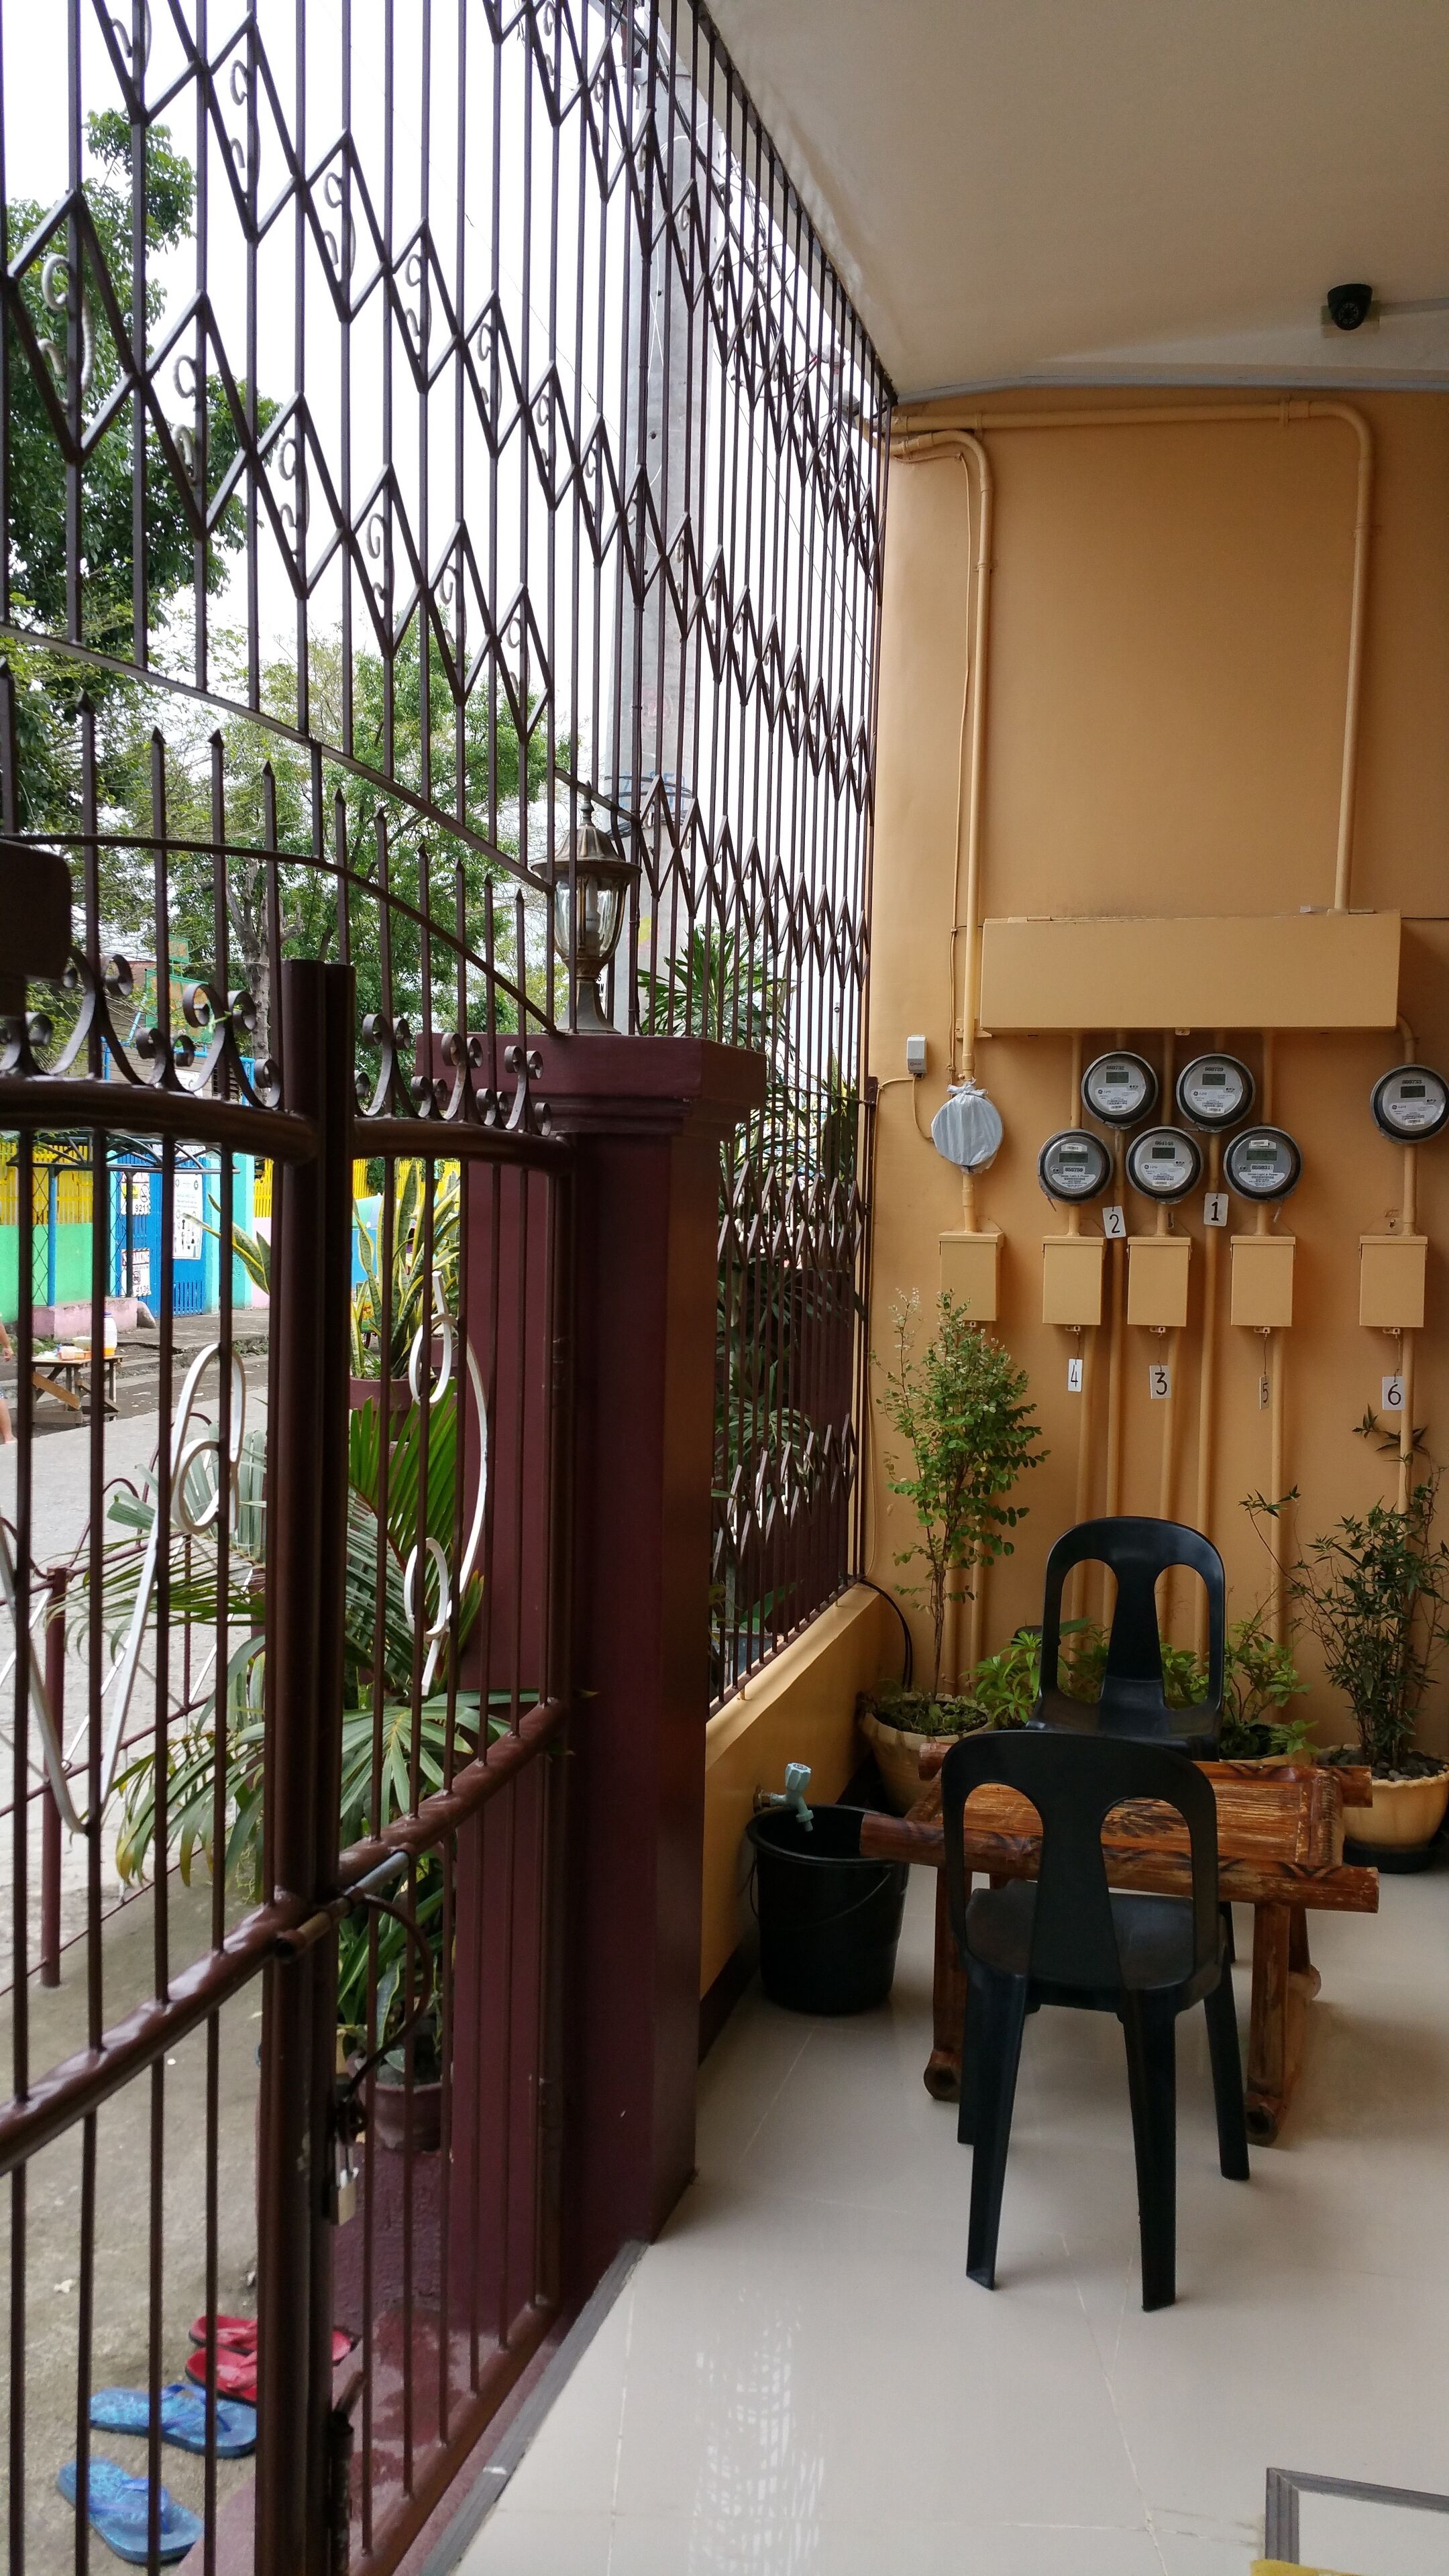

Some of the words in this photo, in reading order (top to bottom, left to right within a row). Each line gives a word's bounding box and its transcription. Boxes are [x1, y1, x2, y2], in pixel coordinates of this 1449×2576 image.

[135, 1204, 149, 1212] 9211
[1211, 1201, 1220, 1222] 1
[1109, 1214, 1121, 1234] 2
[1070, 1364, 1079, 1388] 4
[1154, 1372, 1168, 1395] 3
[1263, 1382, 1269, 1403] 5
[1387, 1383, 1402, 1405] 6
